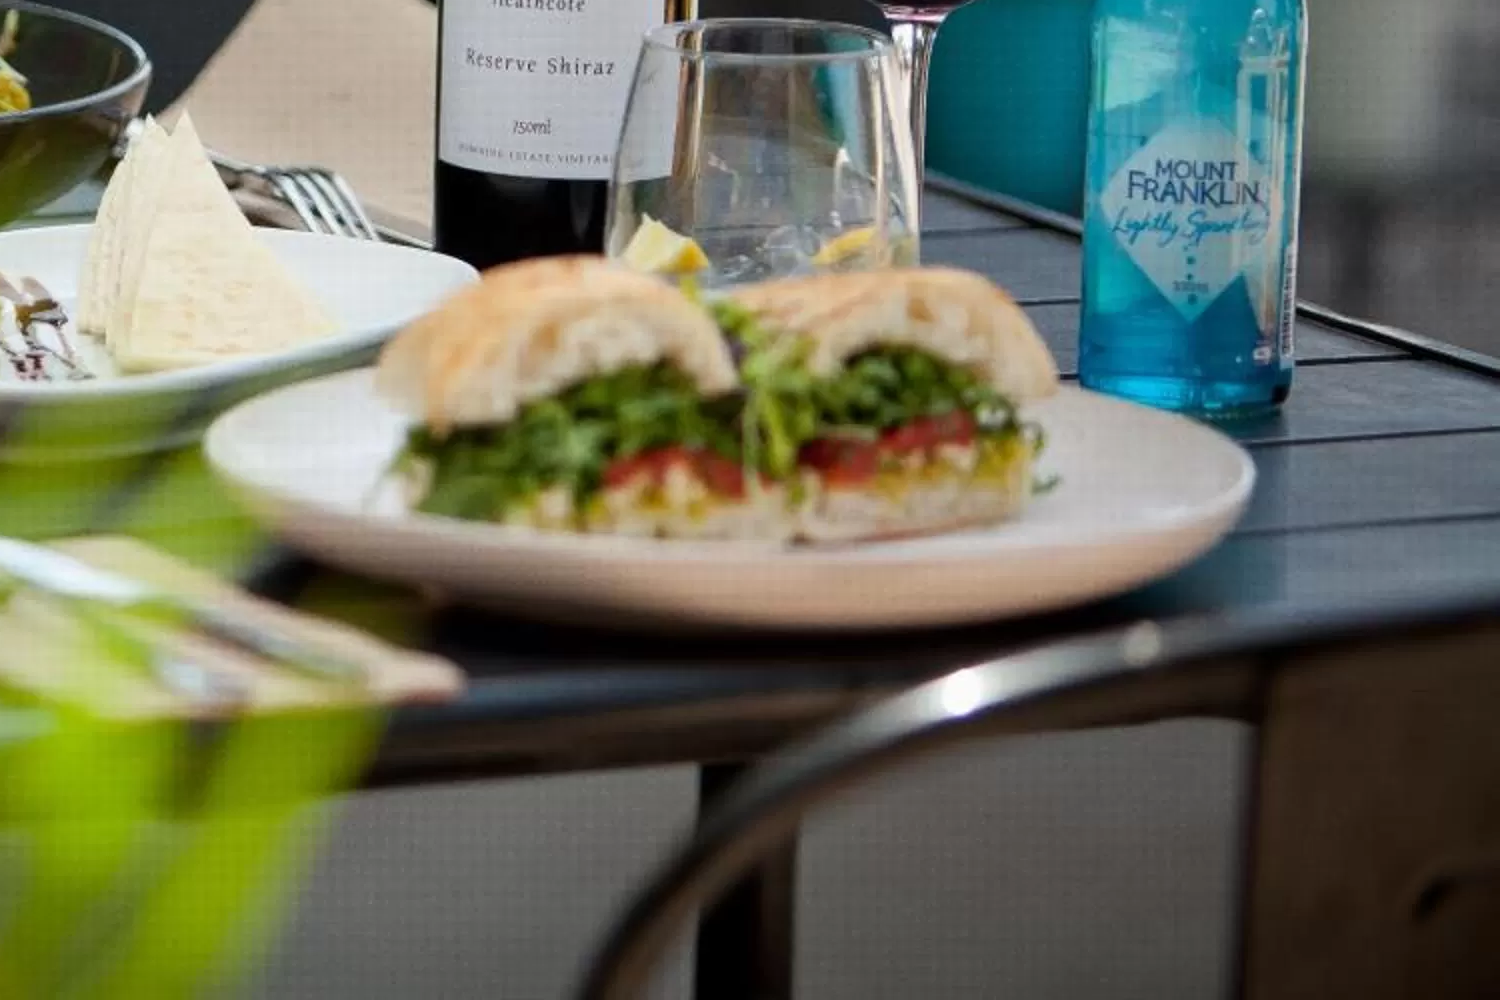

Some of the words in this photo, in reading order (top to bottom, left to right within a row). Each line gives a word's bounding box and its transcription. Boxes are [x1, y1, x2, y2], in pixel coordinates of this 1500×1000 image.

[465, 47, 537, 74] Reserve
[546, 56, 616, 76] Shiraz
[1155, 159, 1238, 181] MOUNT
[1127, 170, 1261, 208] FRANKLIN
